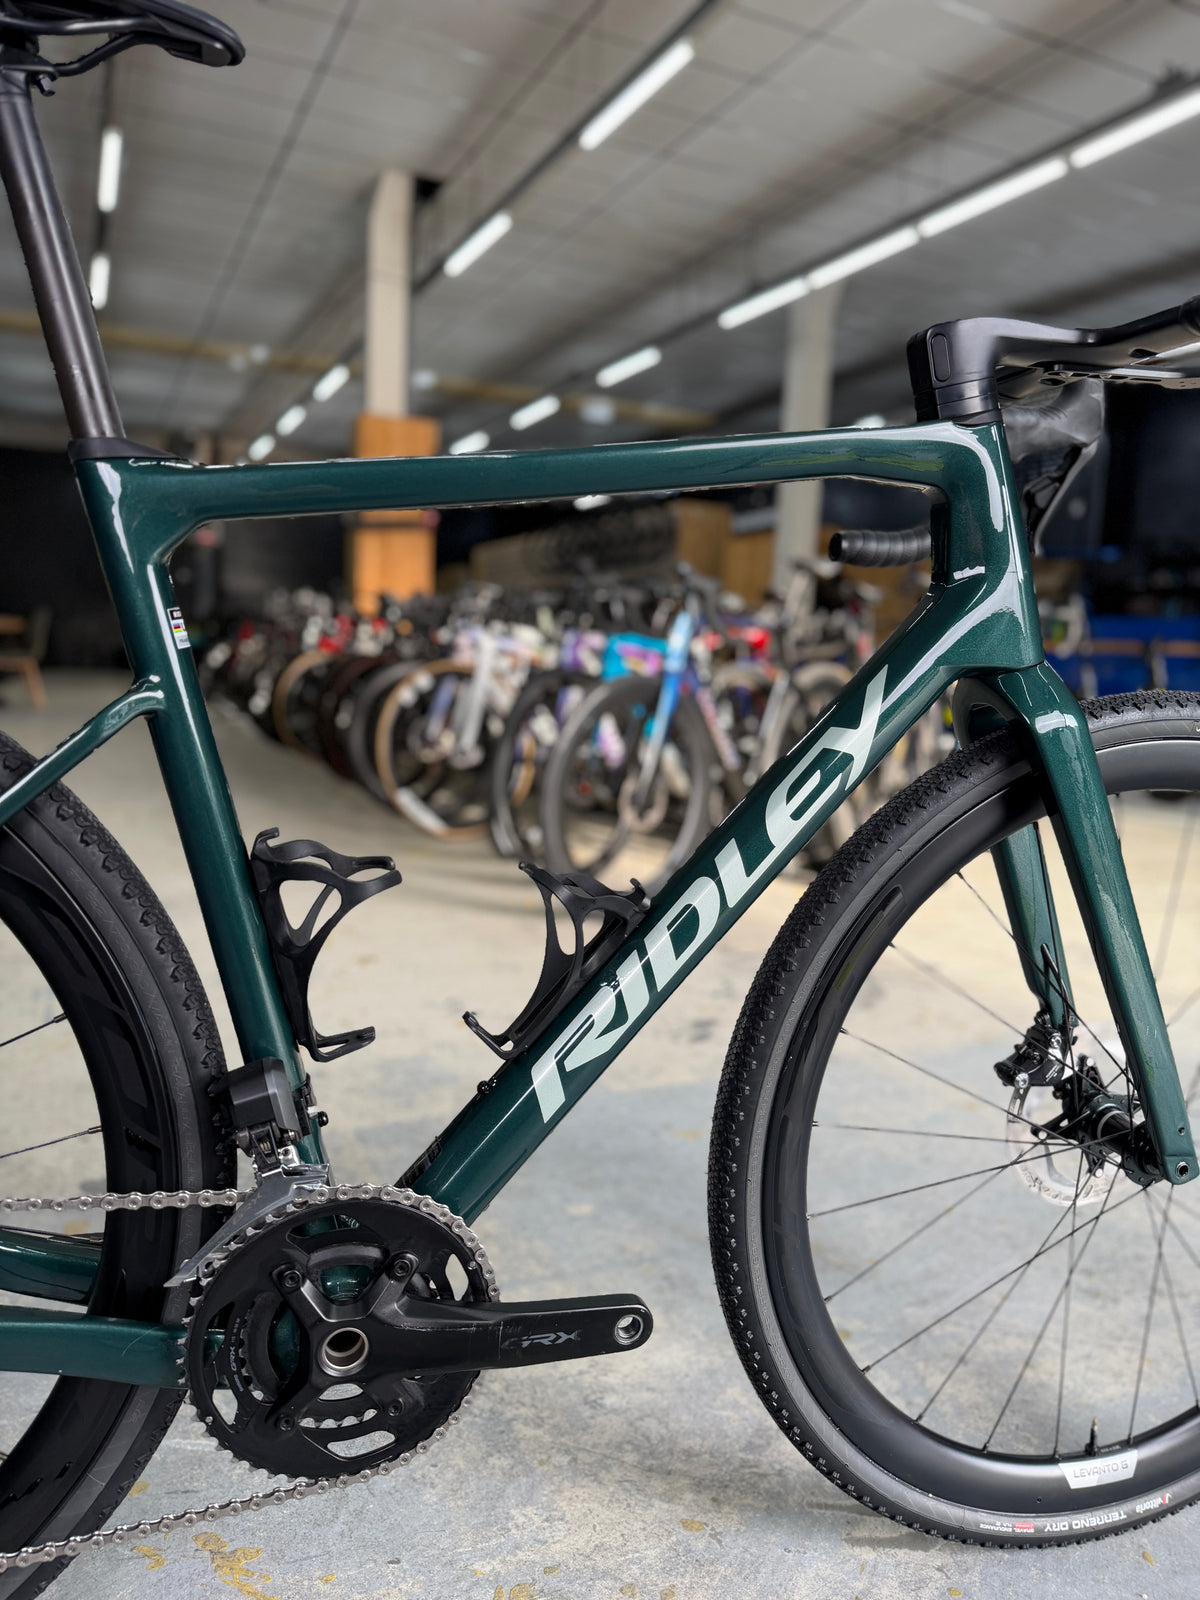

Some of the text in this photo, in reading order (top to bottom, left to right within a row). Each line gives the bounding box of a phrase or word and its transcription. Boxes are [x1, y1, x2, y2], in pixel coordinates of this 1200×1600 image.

[531, 664, 888, 1123] RIDLEY
[229, 1346, 237, 1371] GRX
[1073, 1463, 1119, 1479] LEVANTO
[1135, 1496, 1163, 1515] vittoria
[1044, 1520, 1069, 1532] DRY
[1072, 1511, 1127, 1530] TERRENO
